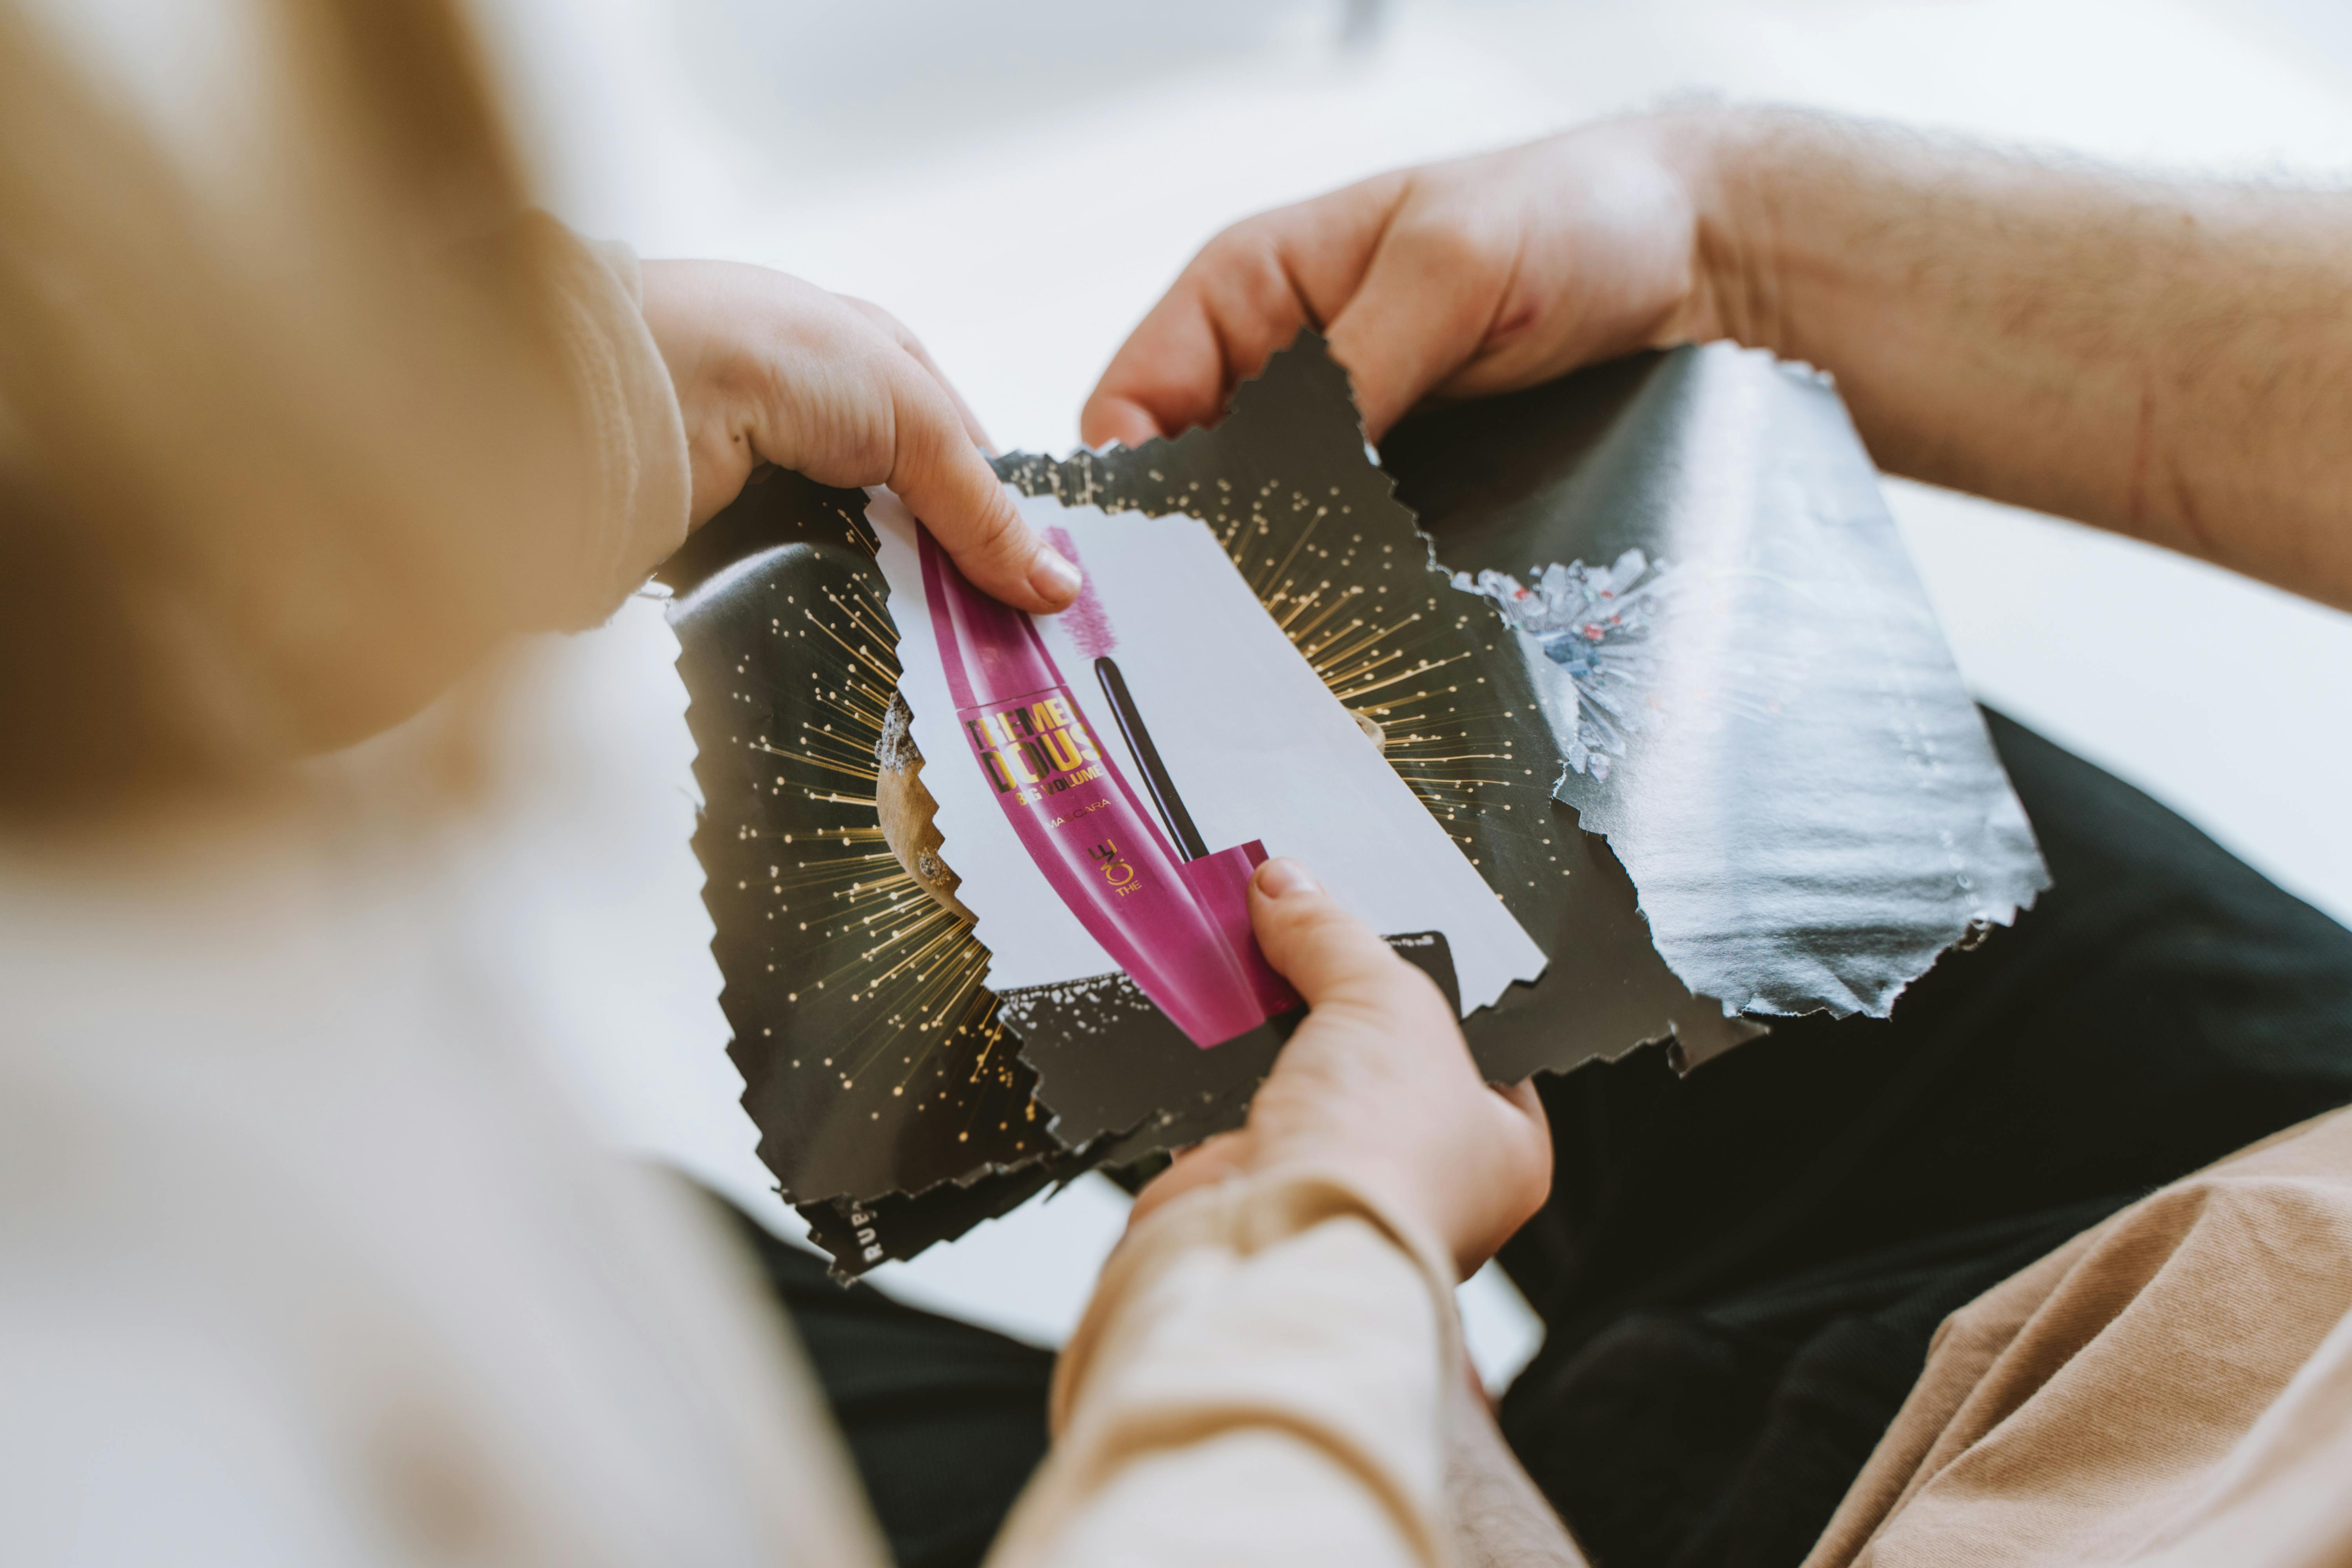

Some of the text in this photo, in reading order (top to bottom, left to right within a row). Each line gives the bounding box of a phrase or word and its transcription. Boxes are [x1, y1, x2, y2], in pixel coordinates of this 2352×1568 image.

[980, 722, 1102, 793] DOUS
[1016, 764, 1103, 806] BIG VOLUME
[1047, 799, 1111, 829] MASCARA
[1116, 880, 1142, 897] THE
